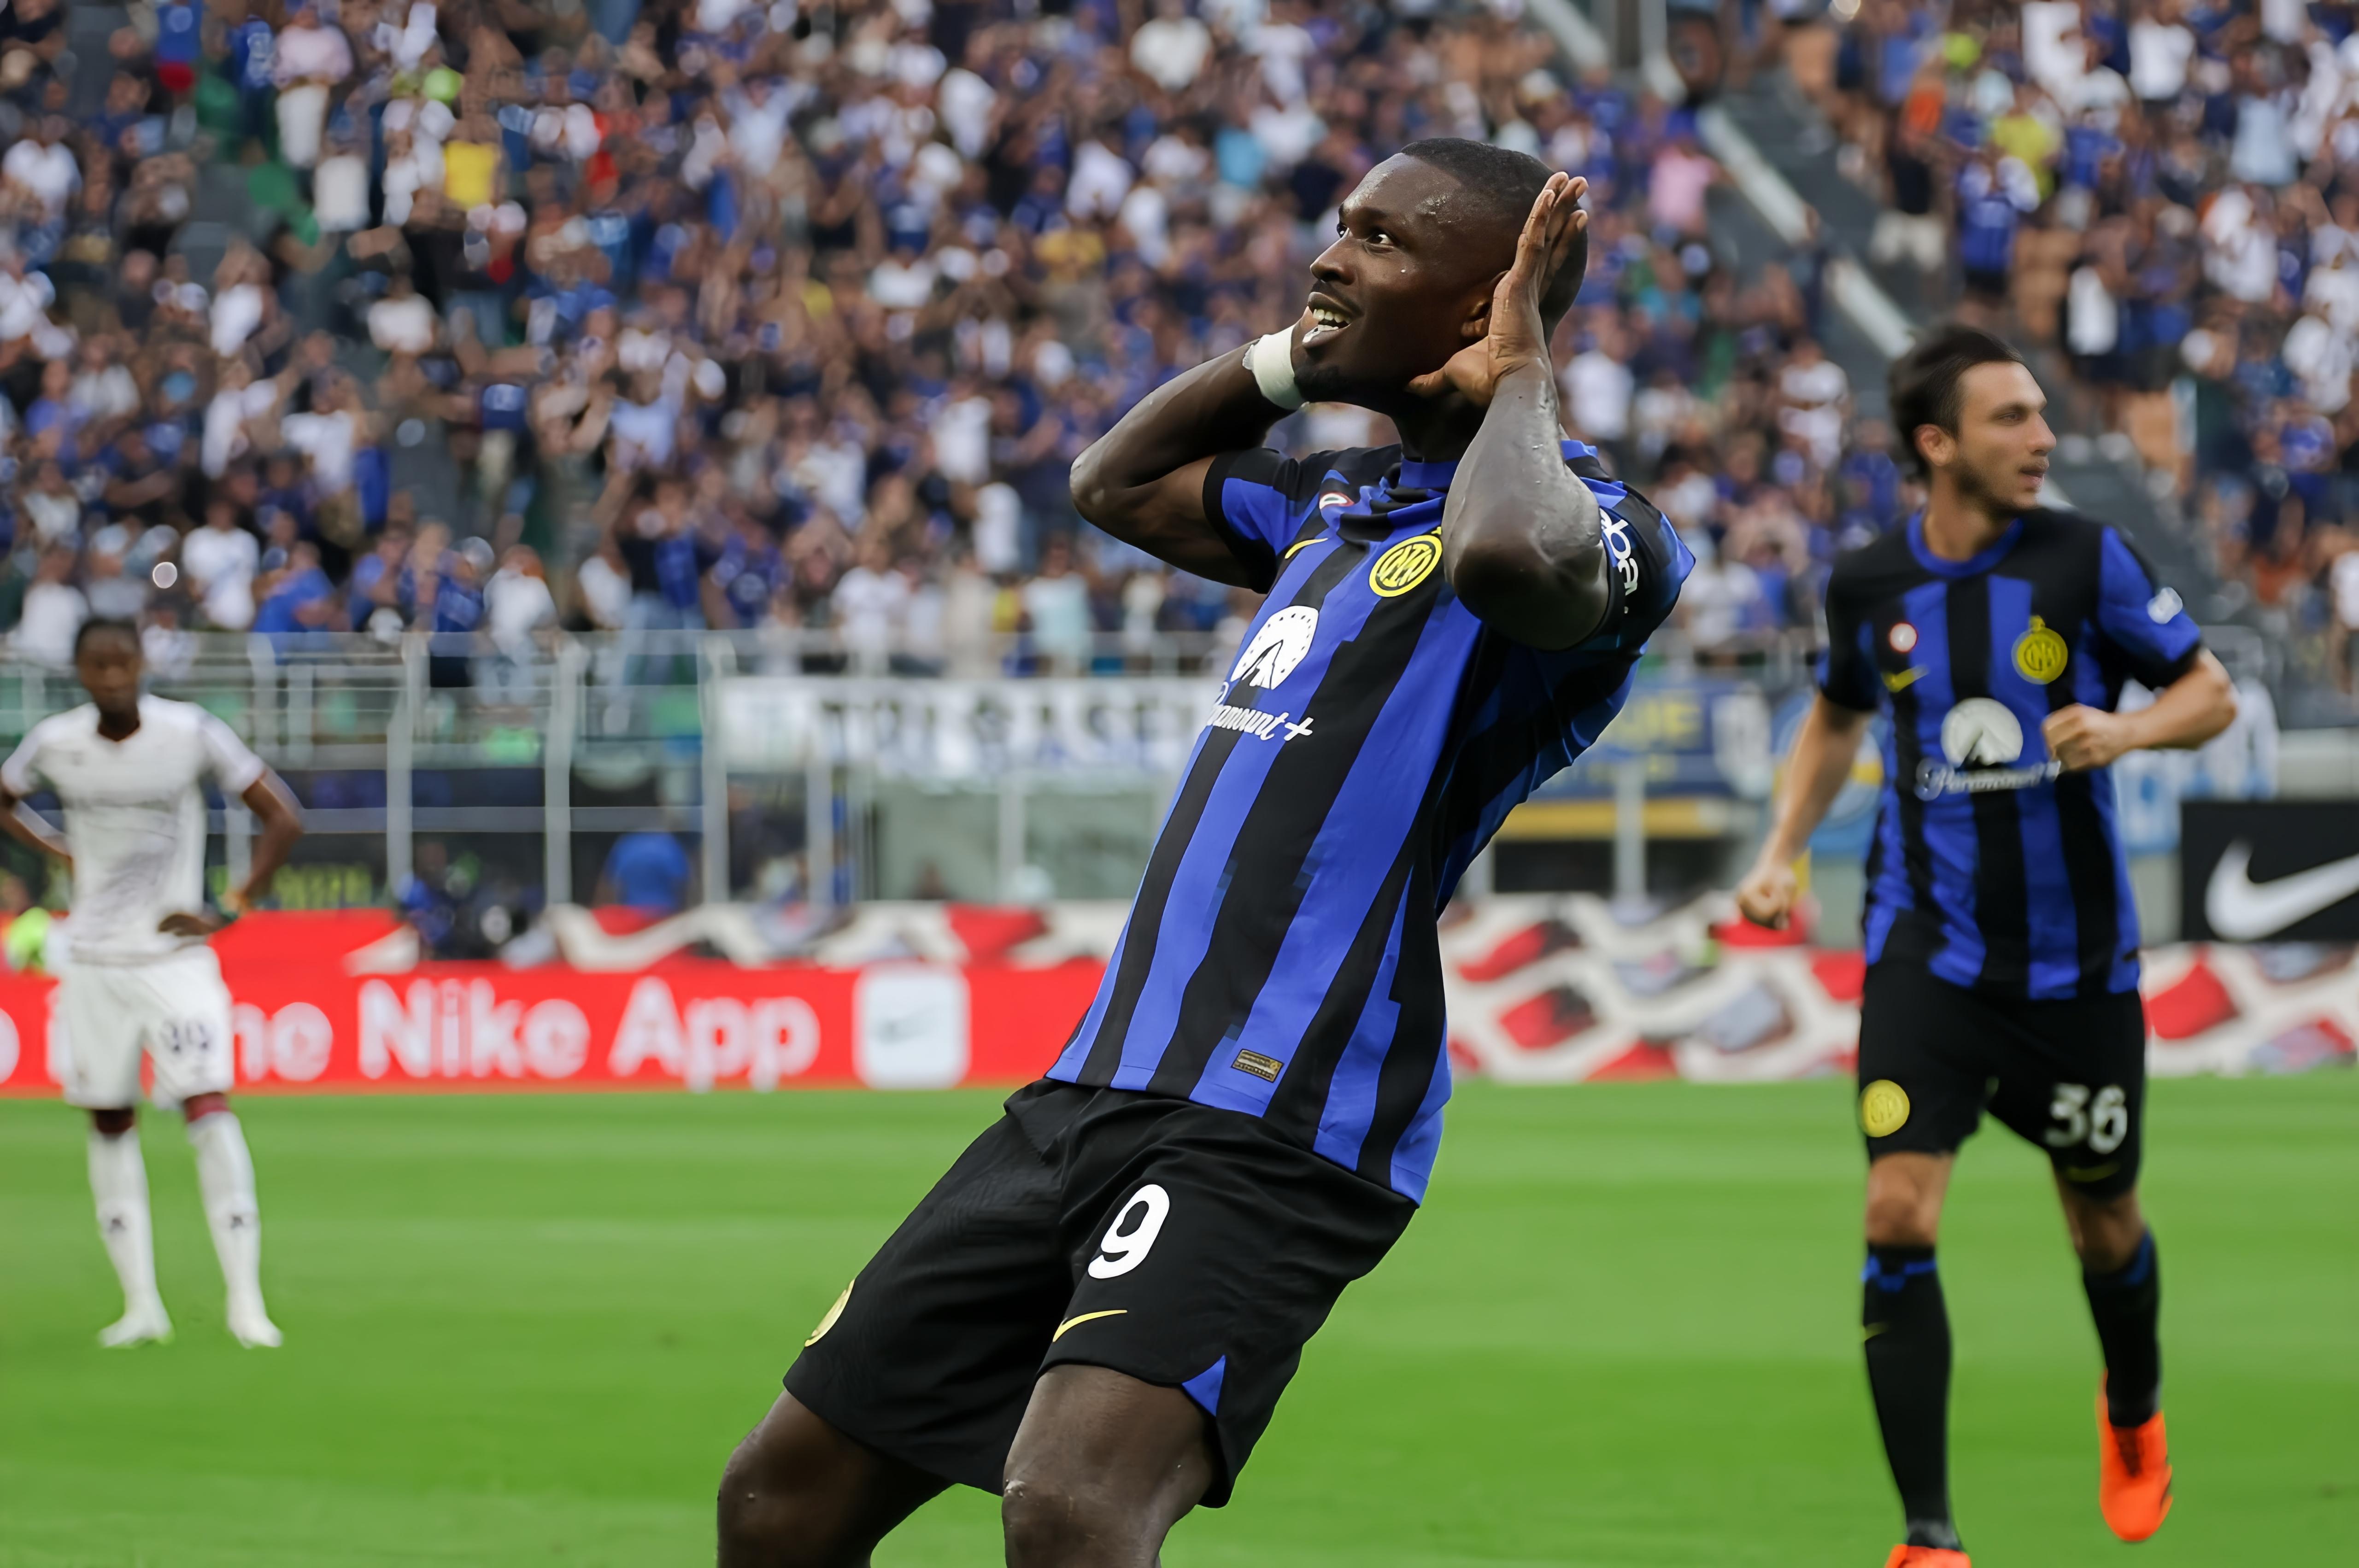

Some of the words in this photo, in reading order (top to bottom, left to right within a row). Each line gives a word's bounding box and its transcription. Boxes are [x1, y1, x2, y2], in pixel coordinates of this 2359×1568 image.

[358, 977, 590, 1080] Nike
[608, 977, 821, 1094] App
[2043, 1082, 2128, 1153] 36
[1087, 1183, 1170, 1279] 9
